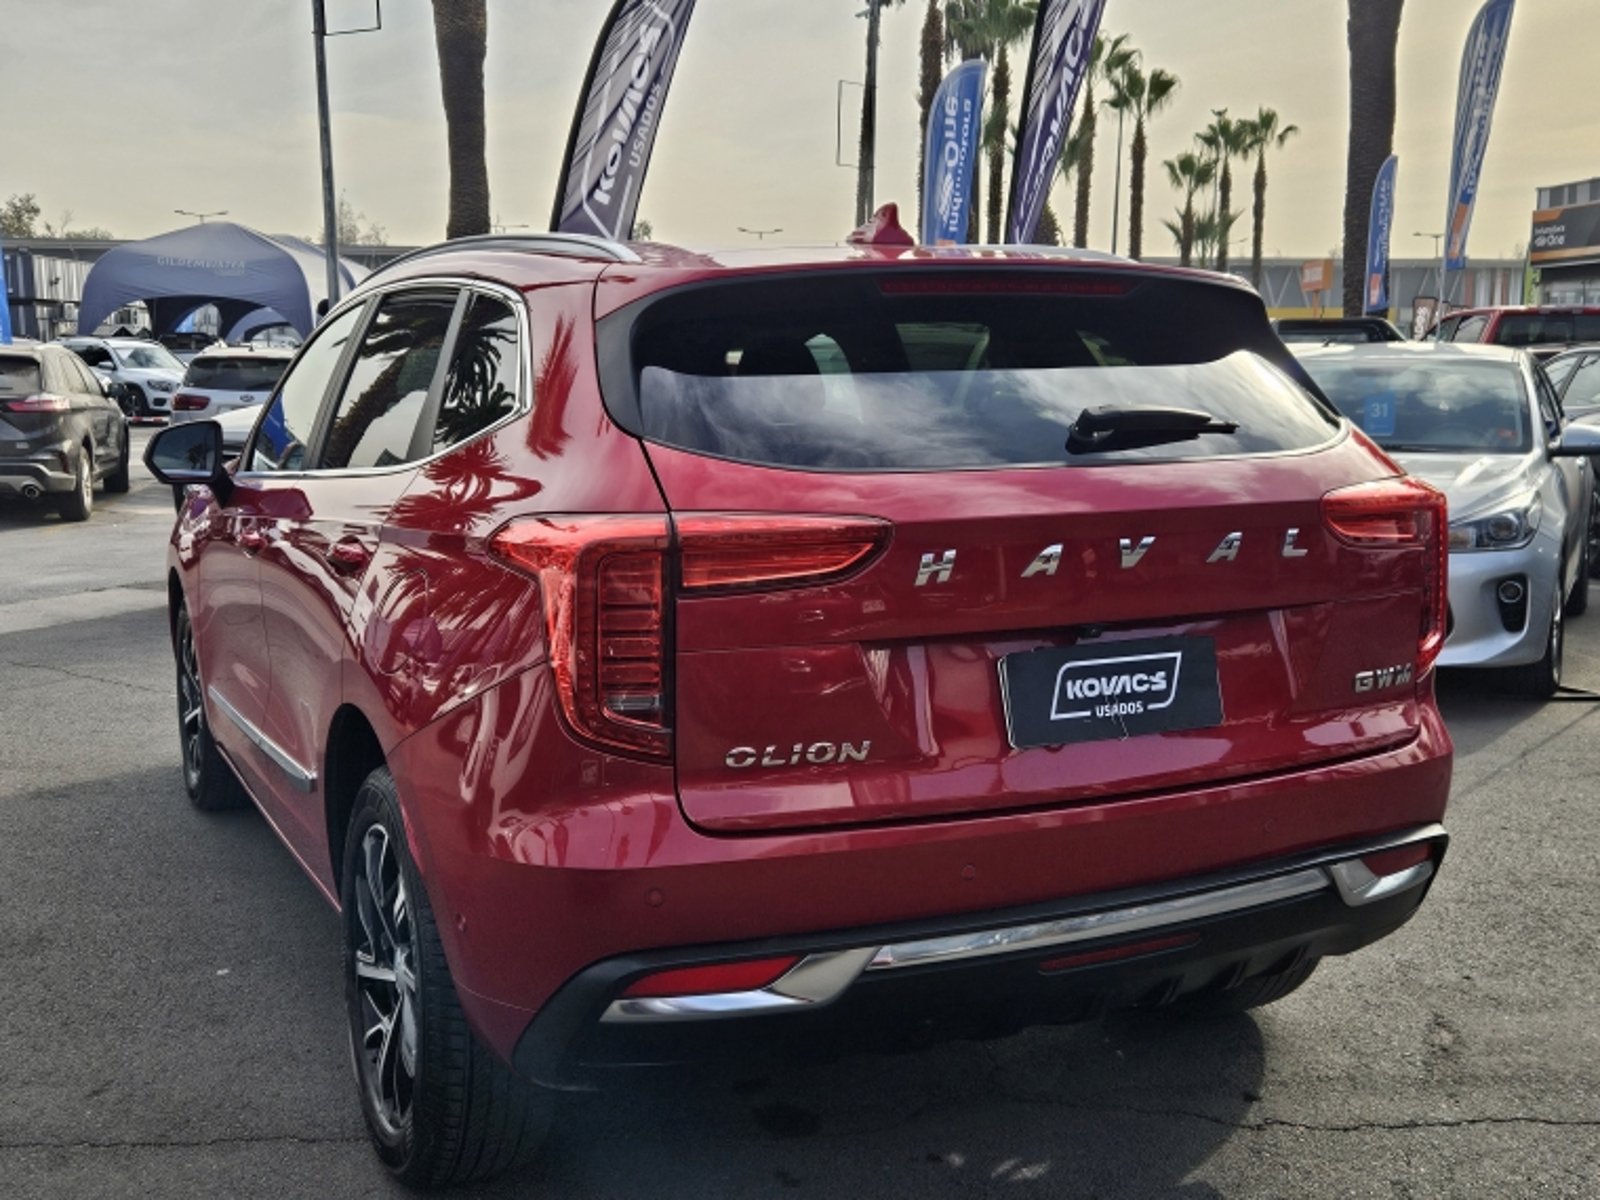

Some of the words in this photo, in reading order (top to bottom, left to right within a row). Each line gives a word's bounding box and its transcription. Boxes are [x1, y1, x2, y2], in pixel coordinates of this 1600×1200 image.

[593, 24, 662, 205] KOVACS
[629, 82, 662, 168] USADOS
[1371, 402, 1388, 417] 31
[914, 528, 1308, 587] HAVAL
[1066, 671, 1167, 699] KOVACS
[1355, 663, 1411, 693] GWM
[1095, 701, 1144, 717] USADOS
[725, 740, 871, 768] OLION
